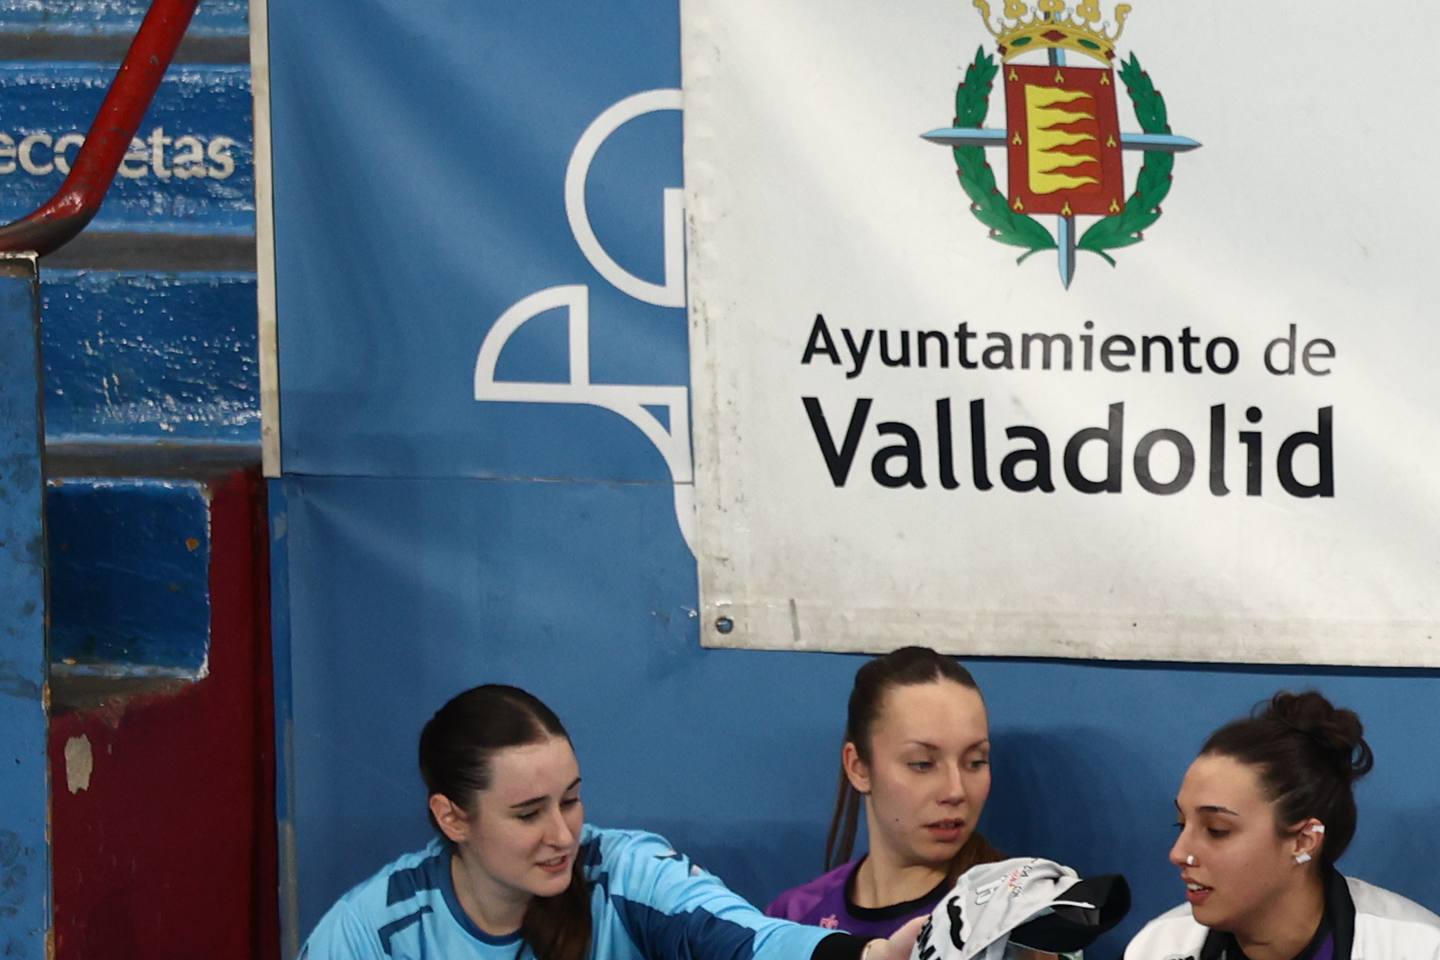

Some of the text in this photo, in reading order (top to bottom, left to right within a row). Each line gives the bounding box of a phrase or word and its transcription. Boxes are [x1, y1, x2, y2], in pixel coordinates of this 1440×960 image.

[801, 313, 1336, 379] Ayuntamiento de
[801, 396, 1335, 499] Valladolid
